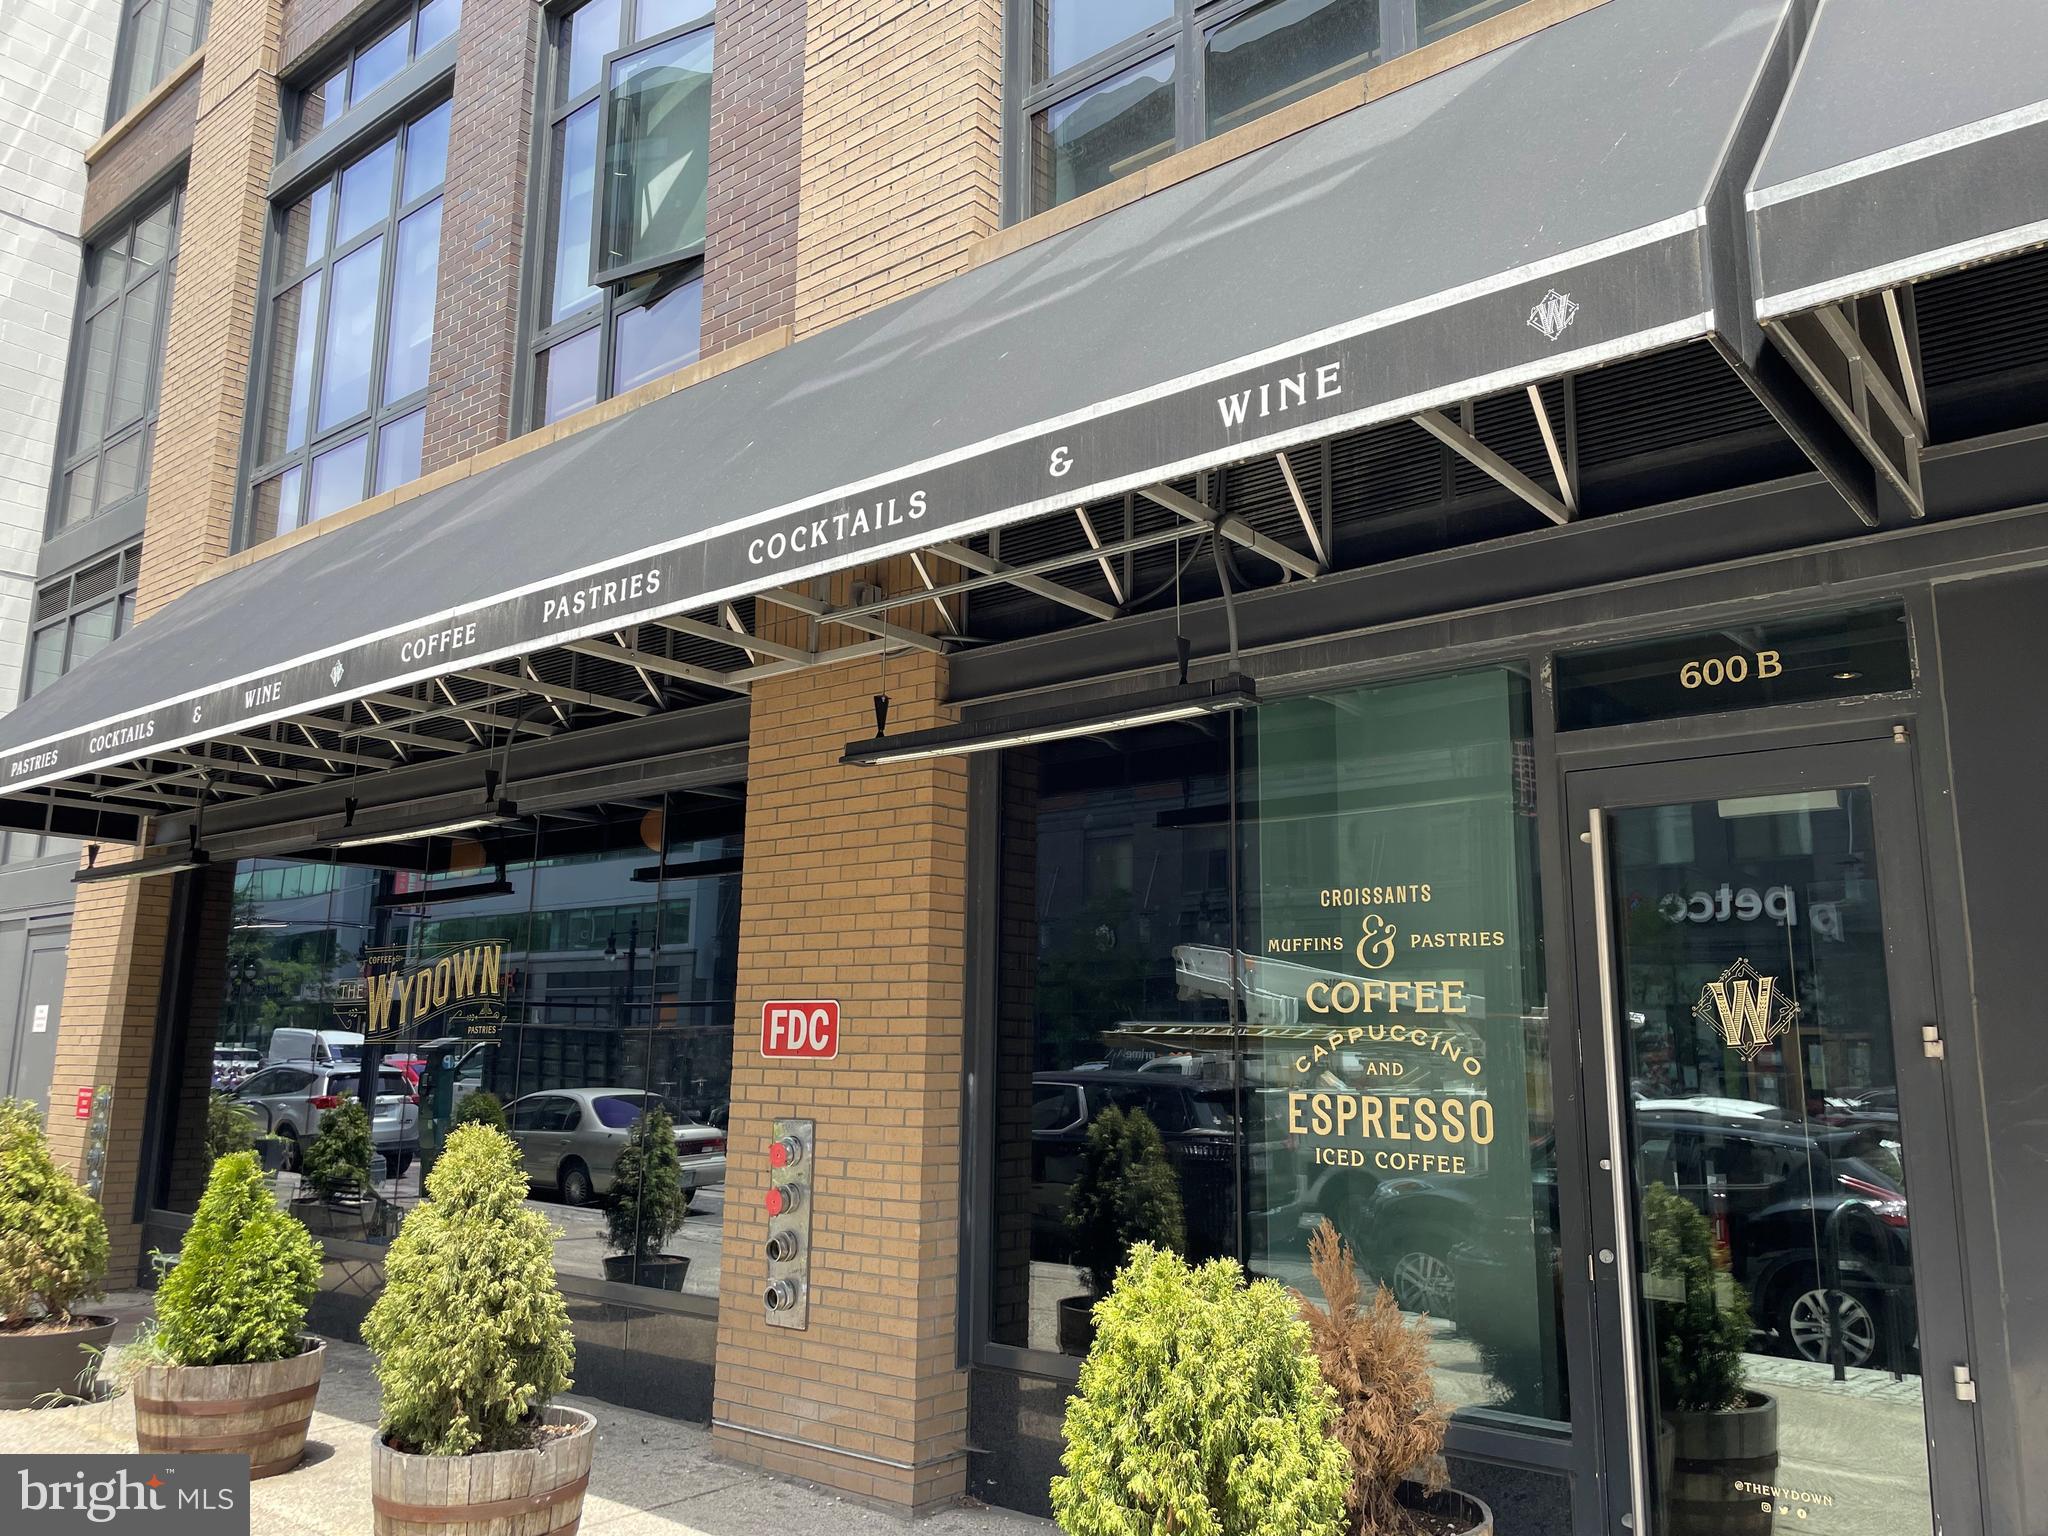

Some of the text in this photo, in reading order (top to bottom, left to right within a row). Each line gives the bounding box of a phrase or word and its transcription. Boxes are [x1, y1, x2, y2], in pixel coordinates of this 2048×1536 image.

[401, 361, 1342, 663] COFFEE PASTRIES COCKTAILS & WINE
[1680, 650, 1783, 689] 600 B
[10, 680, 282, 777] PASTRIES COCKTAILS & WINE
[1320, 884, 1432, 907] CROISSANTS
[368, 955, 393, 965] COFFEE
[1267, 914, 1505, 969] MUFFINS & PASTRIES
[340, 984, 364, 999] THE
[367, 945, 501, 1033] WYDOWN
[1305, 980, 1467, 1014] COFFEE
[467, 1025, 497, 1035] PASTRIES
[769, 1008, 830, 1051] FDC
[1706, 976, 1774, 1047] W
[1295, 1024, 1482, 1077] CAPPUCCINO
[1366, 1062, 1404, 1076] AND
[1288, 1090, 1495, 1145] ESPRESSO
[1315, 1147, 1466, 1174] ICED COFFEE
[1734, 1480, 1833, 1507] @THEWYDOWN
